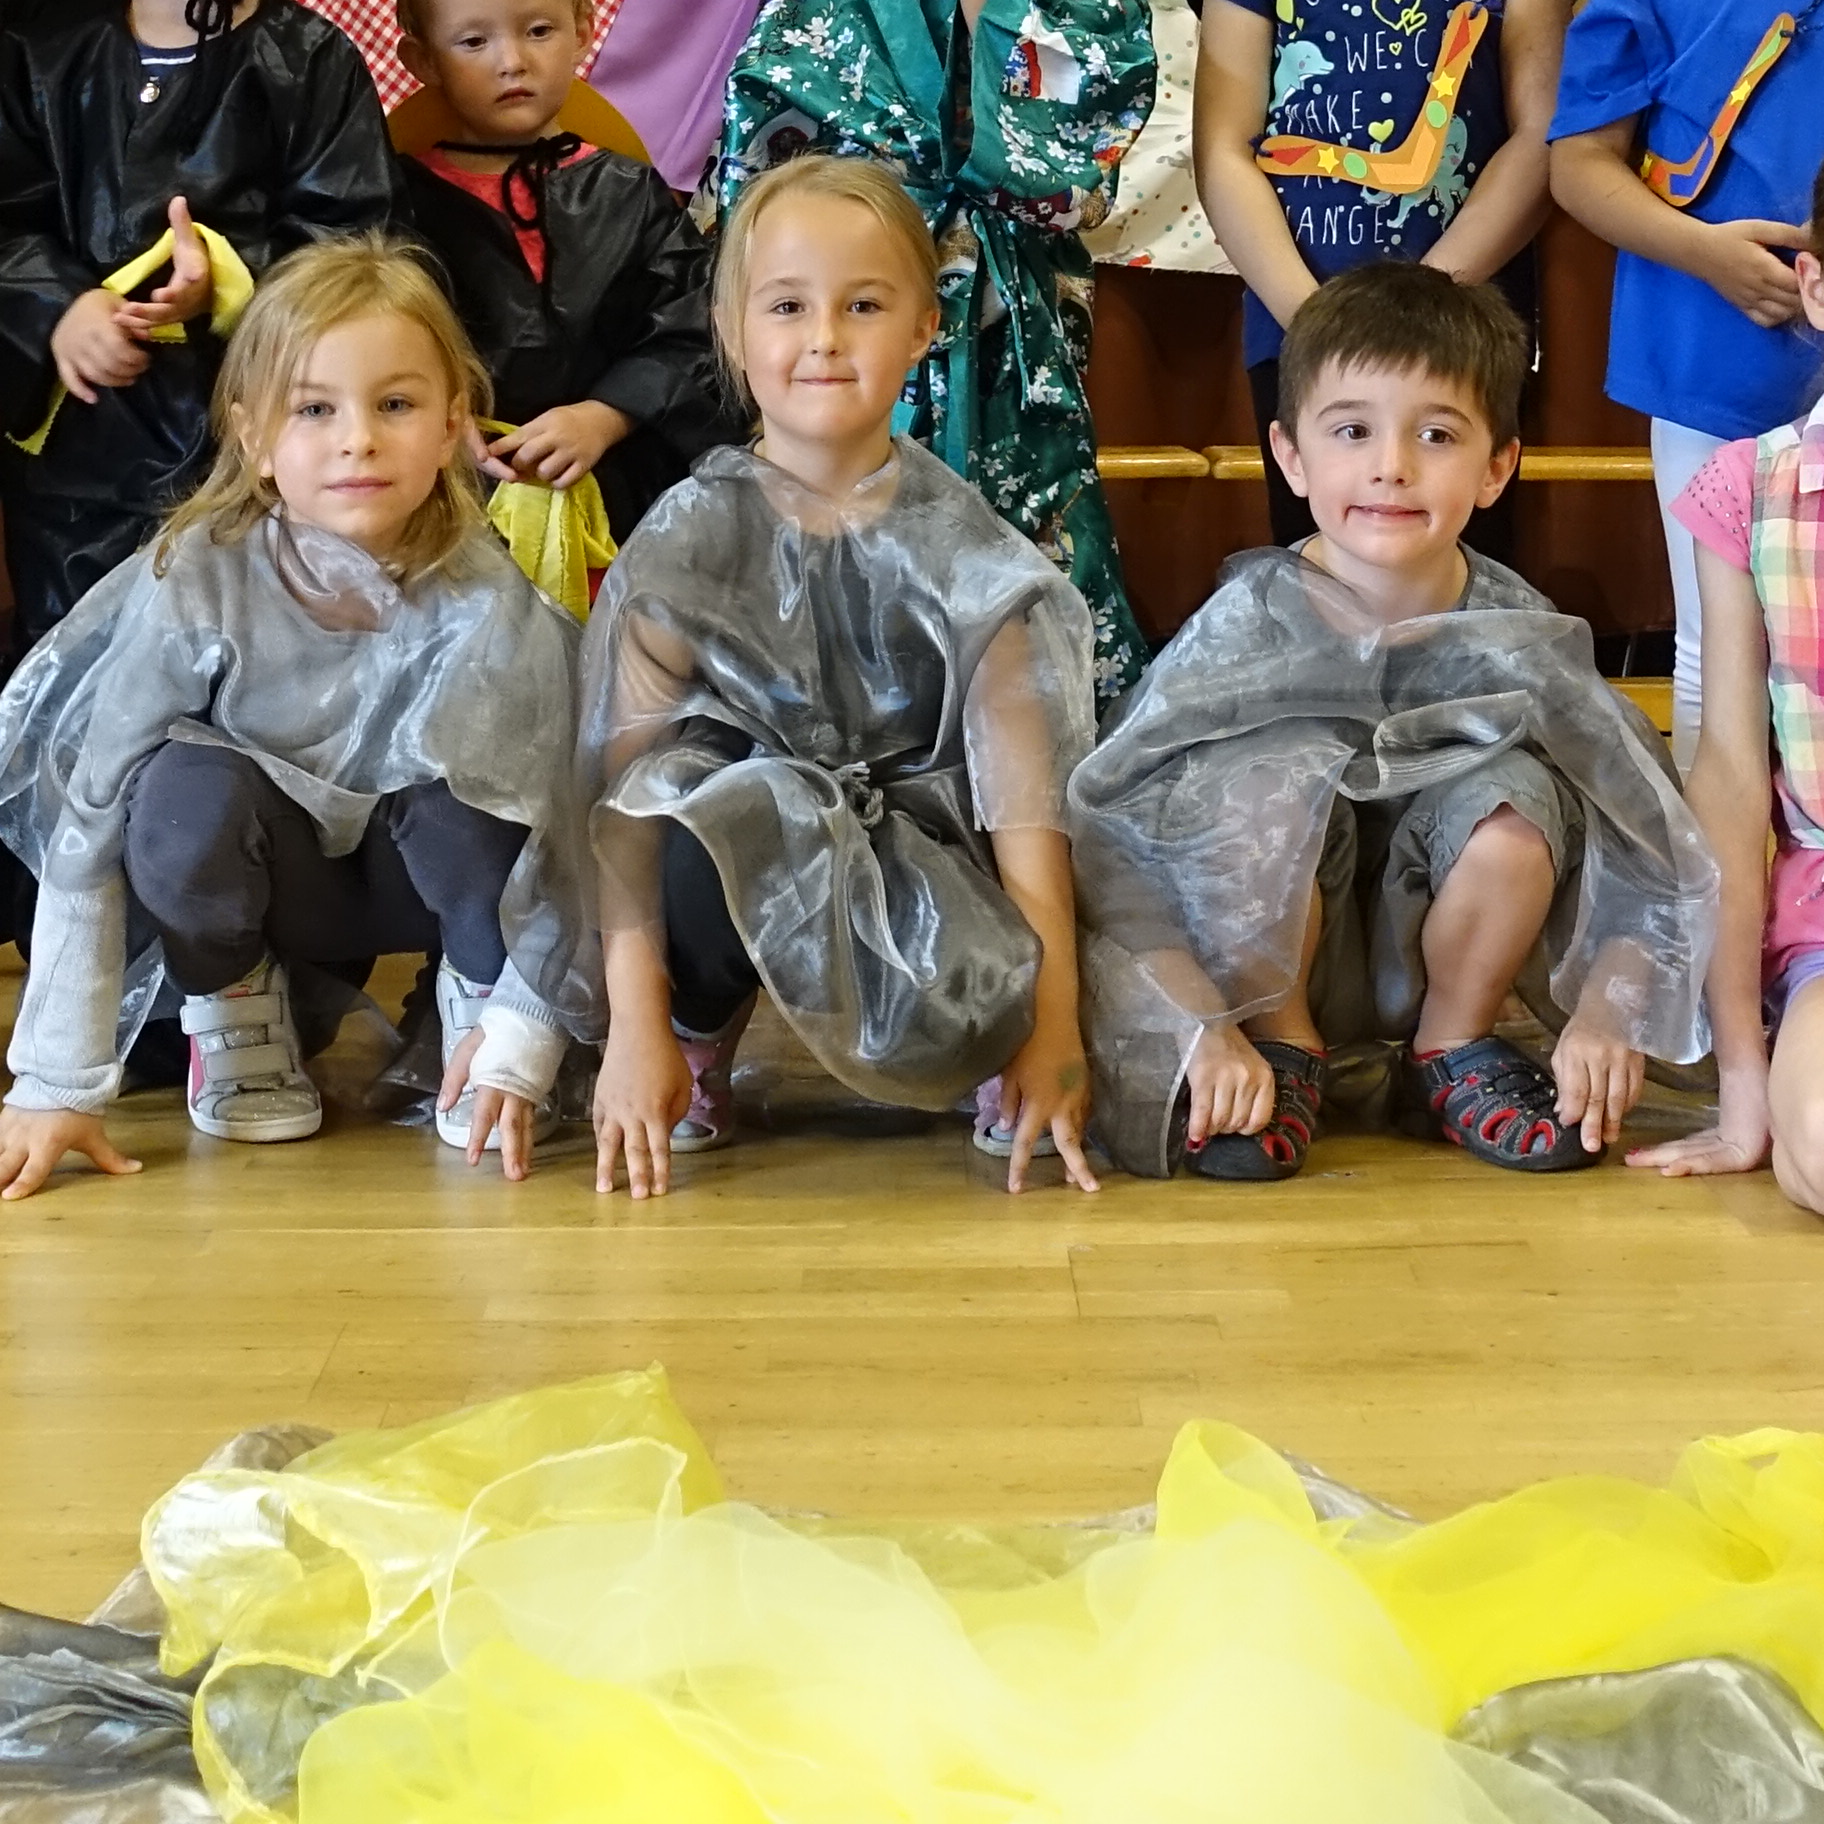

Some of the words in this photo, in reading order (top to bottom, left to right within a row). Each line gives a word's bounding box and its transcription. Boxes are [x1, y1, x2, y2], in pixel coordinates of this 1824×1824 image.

[1344, 30, 1388, 73] WE
[1284, 89, 1363, 135] MAKE
[1286, 204, 1386, 245] ANGE
